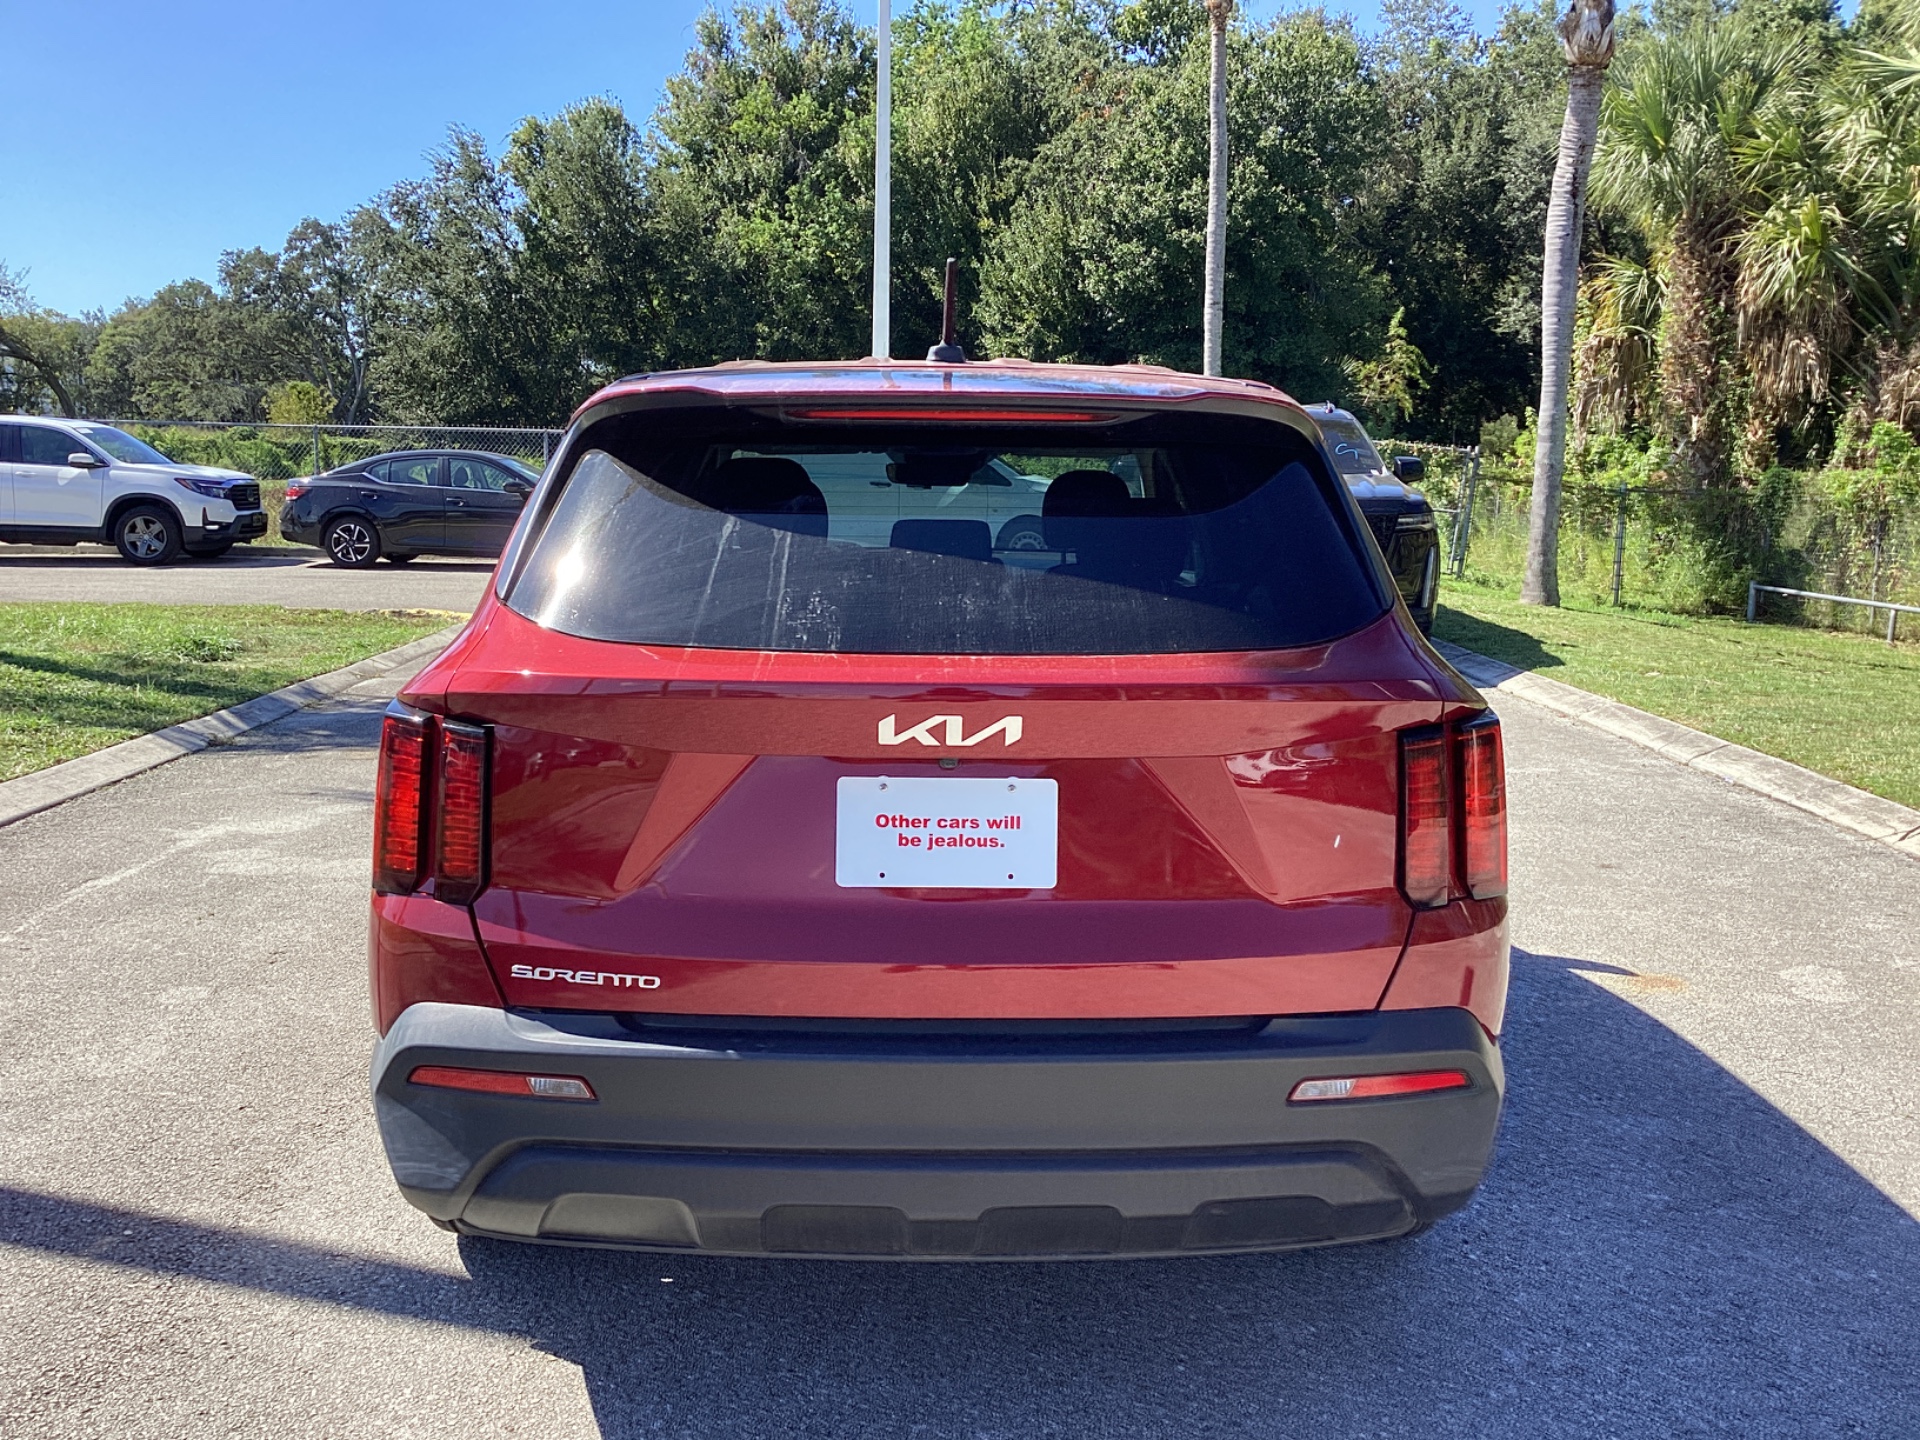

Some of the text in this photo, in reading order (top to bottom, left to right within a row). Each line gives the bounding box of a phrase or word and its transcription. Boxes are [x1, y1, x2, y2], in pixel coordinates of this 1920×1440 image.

[878, 713, 1023, 746] KIA
[875, 814, 1021, 830] Other cars will
[898, 833, 1005, 851] be jealous.
[511, 964, 661, 989] SORENTO
